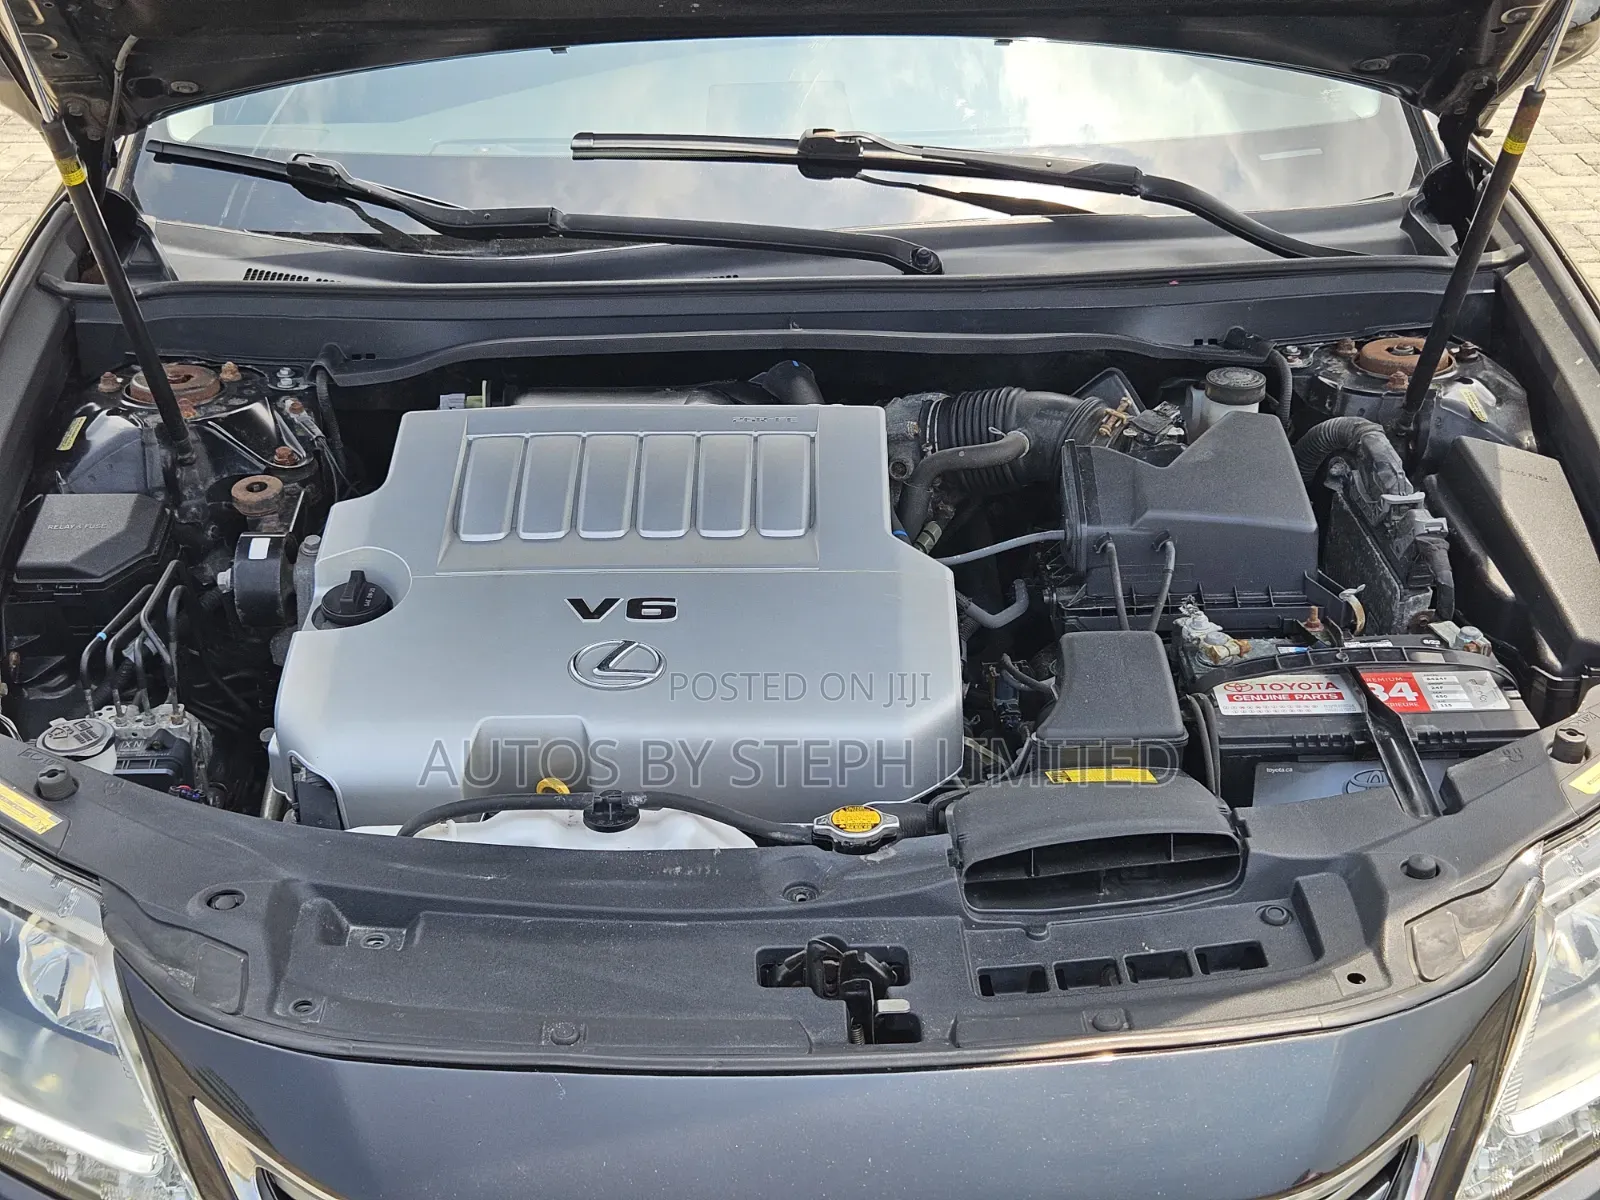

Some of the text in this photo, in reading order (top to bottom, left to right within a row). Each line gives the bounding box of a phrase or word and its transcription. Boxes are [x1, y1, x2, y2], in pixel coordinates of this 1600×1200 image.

[564, 597, 678, 622] V6
[1256, 682, 1340, 691] TOYOTA
[1233, 692, 1338, 702] GENUINE PARTS
